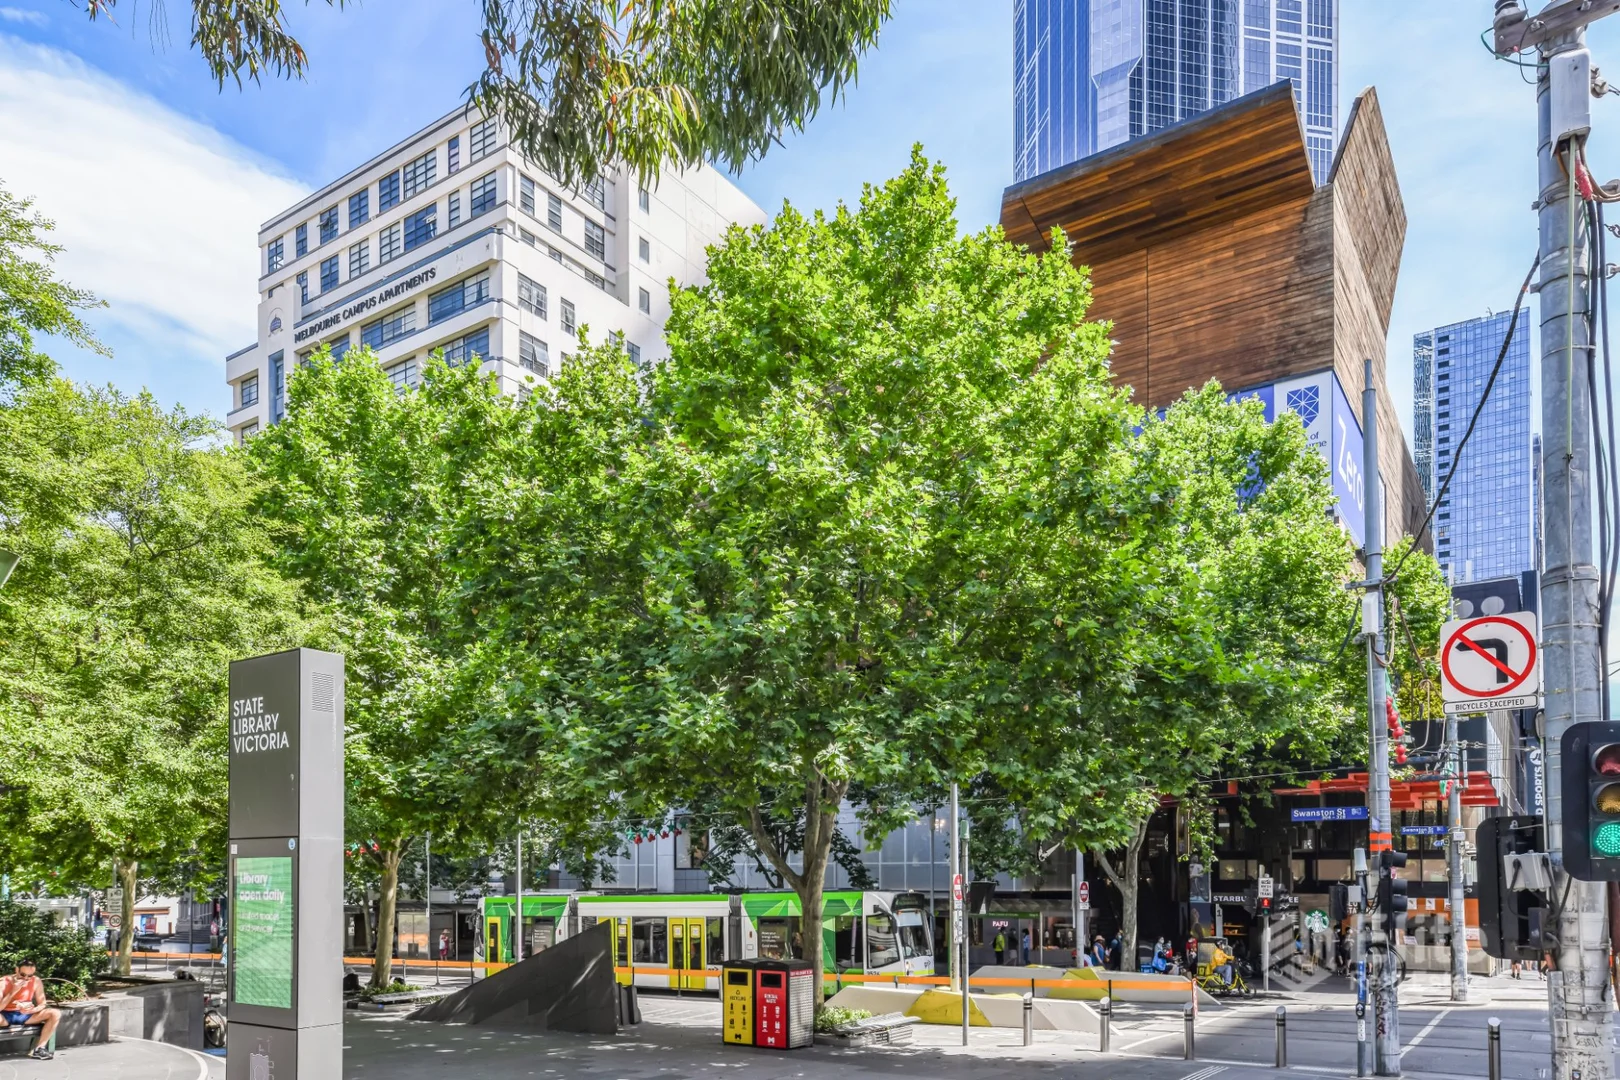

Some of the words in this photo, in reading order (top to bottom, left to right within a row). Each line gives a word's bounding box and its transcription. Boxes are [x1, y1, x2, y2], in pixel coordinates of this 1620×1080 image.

[294, 313, 341, 343] MELBOURNE
[342, 296, 376, 320] CAMPUS
[378, 267, 436, 304] APARTMENTS
[1338, 414, 1363, 512] Zero
[233, 696, 264, 717] STATE
[1455, 701, 1488, 711] BICYCLES
[1489, 698, 1525, 708] EXCEPTED
[233, 712, 279, 736] LIBRARY
[233, 731, 290, 753] VICTORIA
[1534, 766, 1543, 805] SPORTS
[1293, 808, 1335, 817] Swanston
[1336, 807, 1346, 815] St
[239, 871, 269, 887] Library
[239, 890, 262, 903] open
[263, 889, 285, 903] daily
